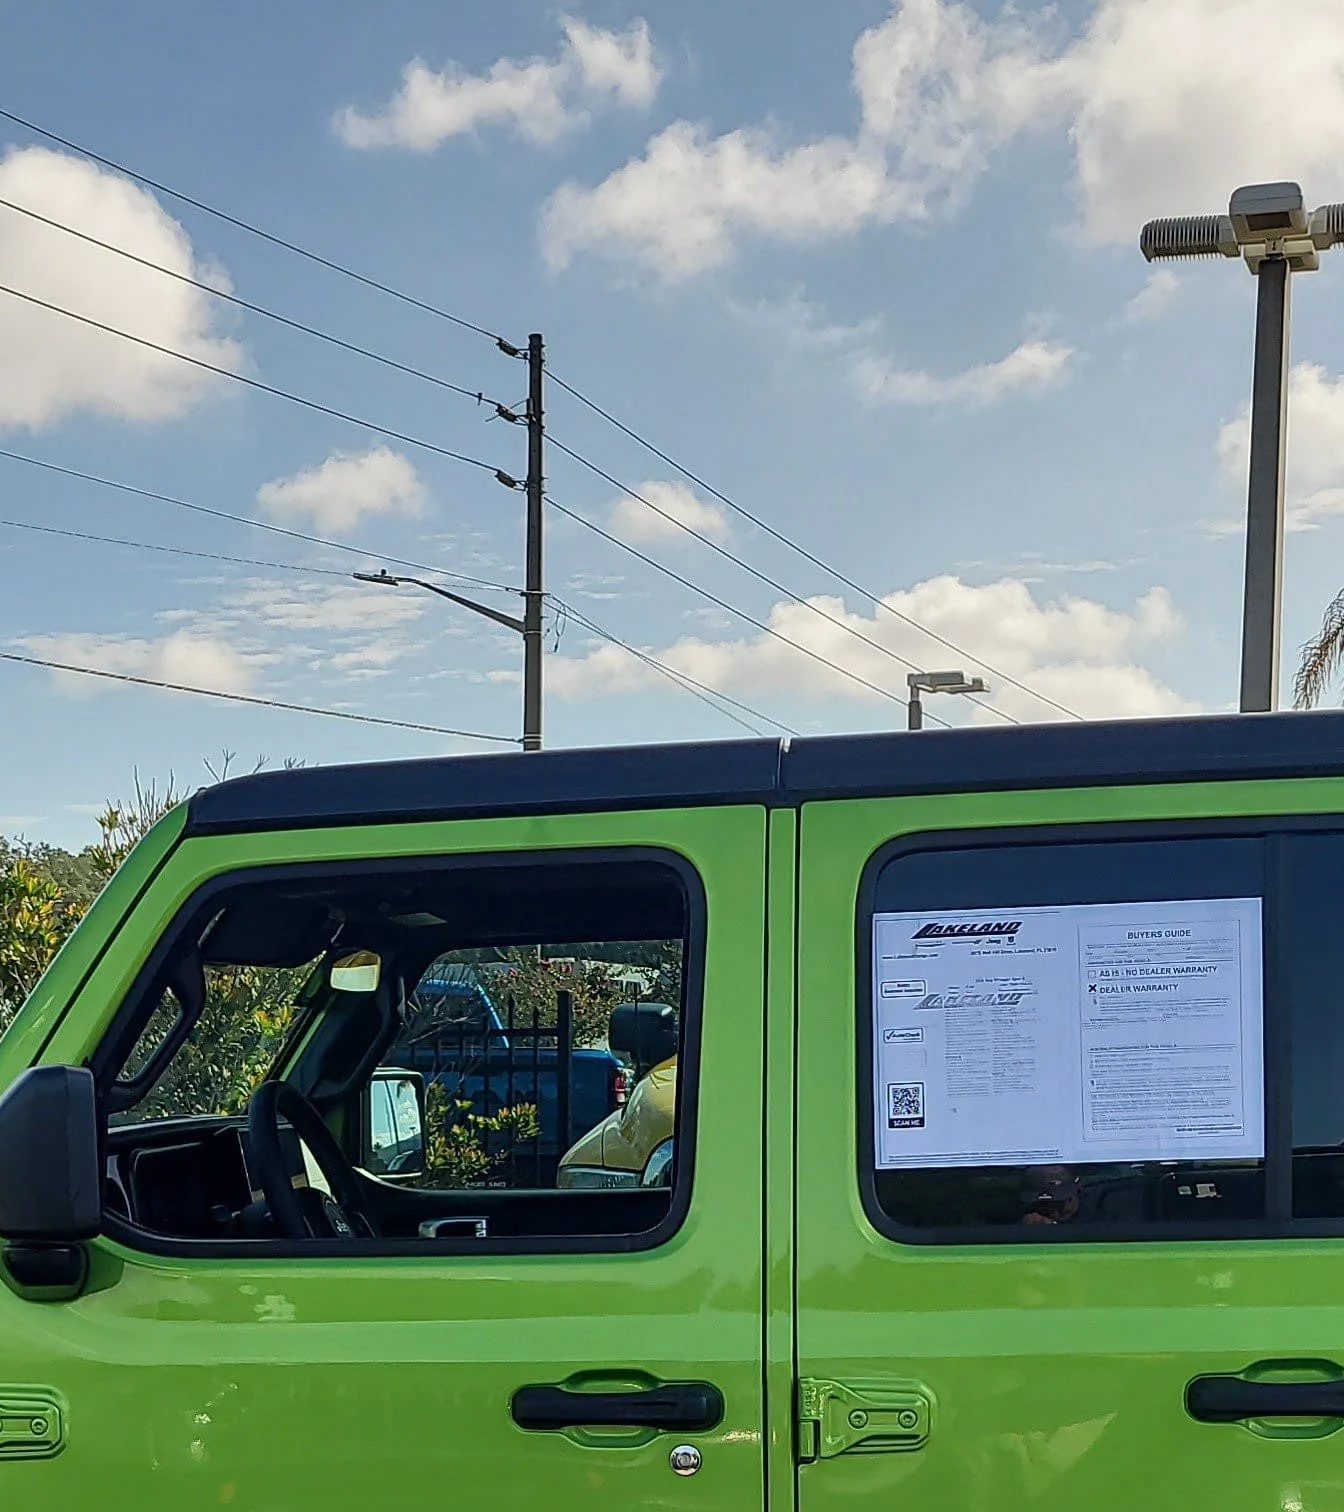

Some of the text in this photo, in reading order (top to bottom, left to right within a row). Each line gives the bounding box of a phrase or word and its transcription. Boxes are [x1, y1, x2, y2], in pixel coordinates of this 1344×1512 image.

[910, 921, 1023, 940] LAKELAND
[1127, 929, 1192, 940] BUYERS GUIDE
[1139, 967, 1171, 975] DEALER
[1173, 965, 1218, 974] WARRANTY
[1099, 984, 1179, 994] DEALER WARRANTY
[893, 1119, 910, 1127] SCAN
